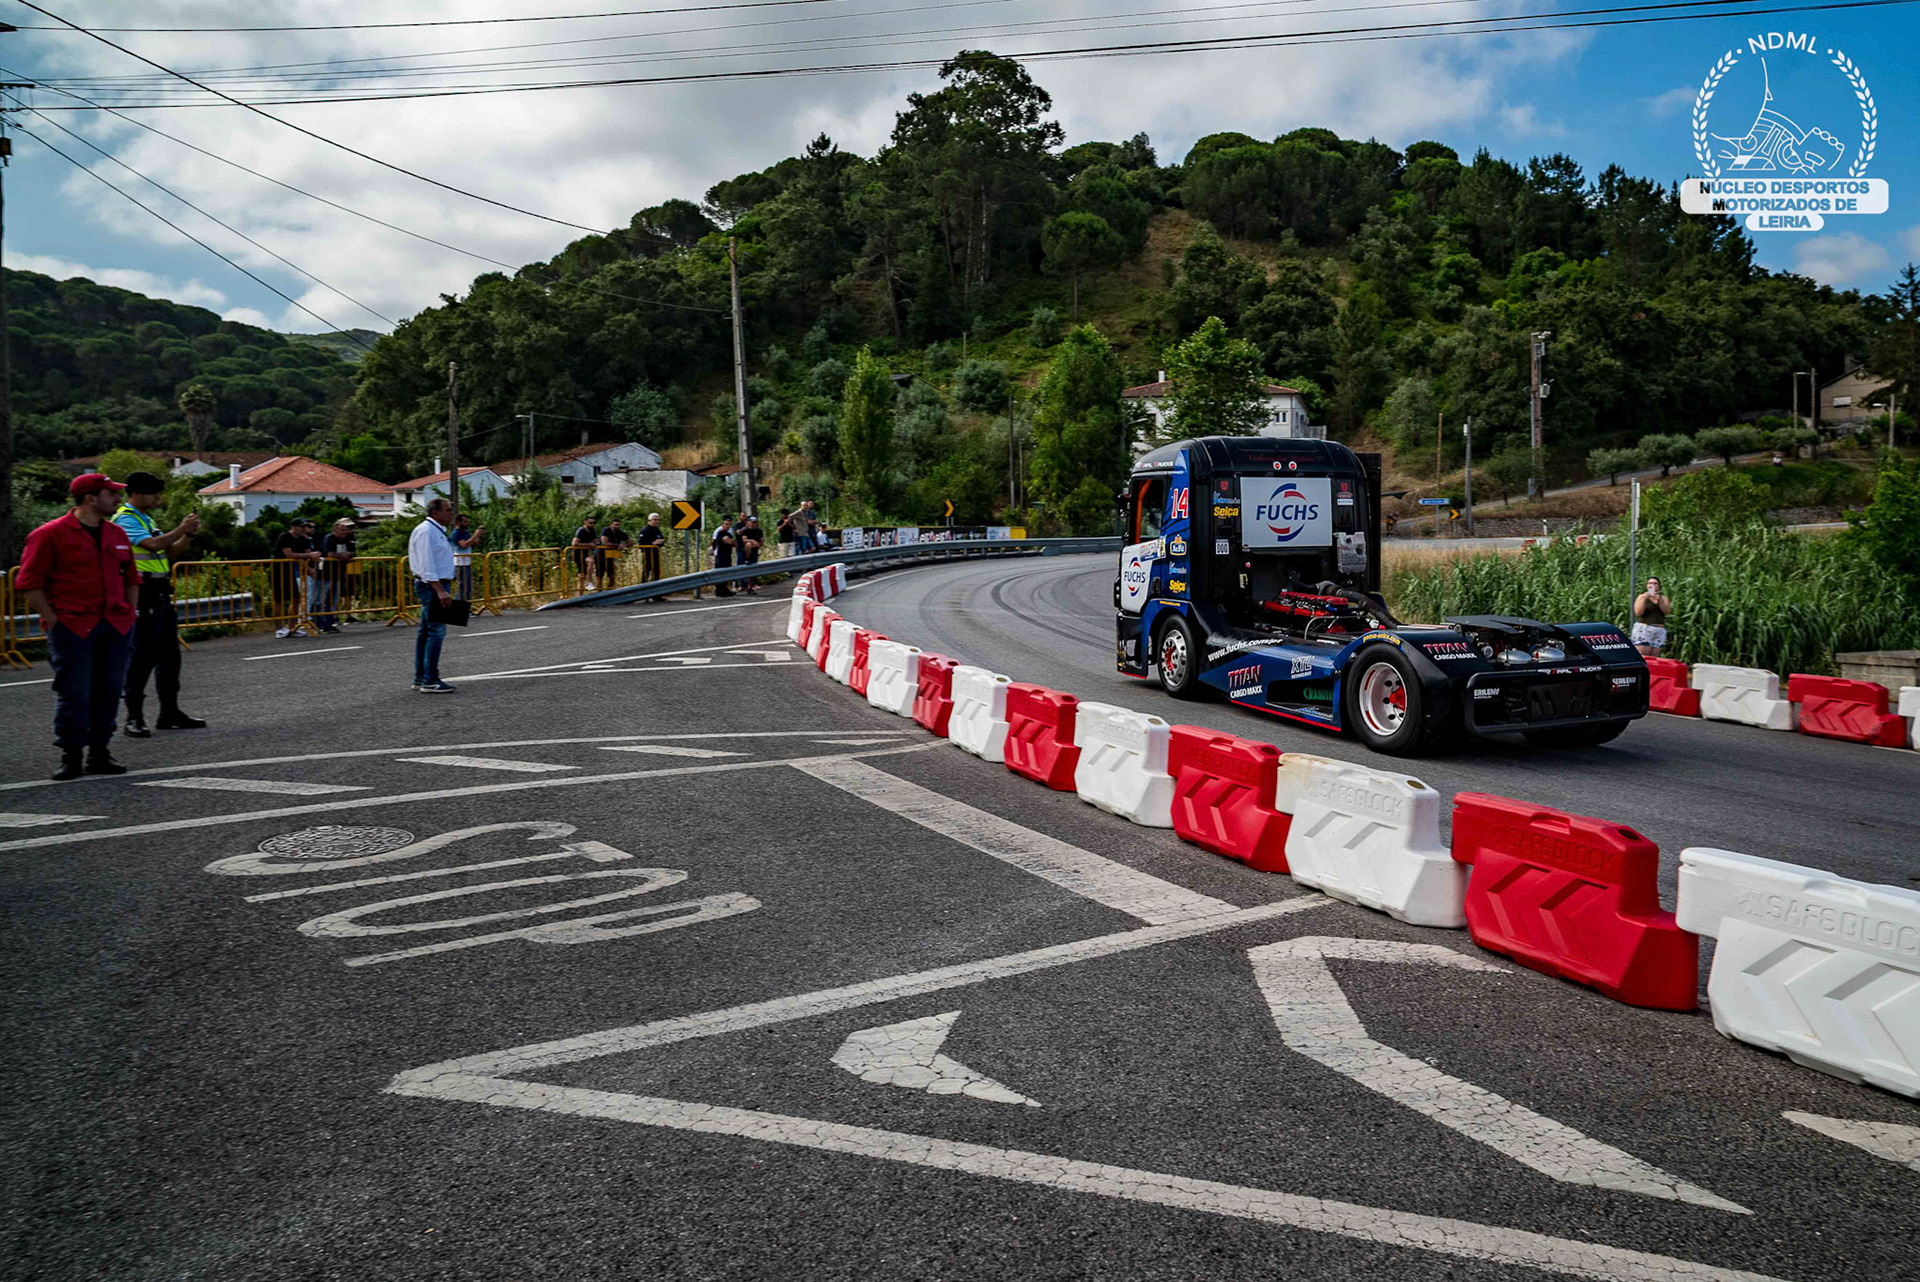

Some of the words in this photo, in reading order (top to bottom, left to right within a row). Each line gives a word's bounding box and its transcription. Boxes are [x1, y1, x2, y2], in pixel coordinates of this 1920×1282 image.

[1171, 487, 1189, 519] 14
[1256, 504, 1319, 521] FUCHS
[1123, 571, 1146, 584] FUCHS
[1423, 642, 1470, 655] TITAN
[1433, 653, 1458, 661] CARGO
[1458, 652, 1478, 660] MAXX
[1227, 664, 1263, 689] TITAN
[1230, 688, 1247, 699] CARGO
[1247, 685, 1263, 696] MAXX
[1319, 780, 1403, 819] SAFEBLOCK
